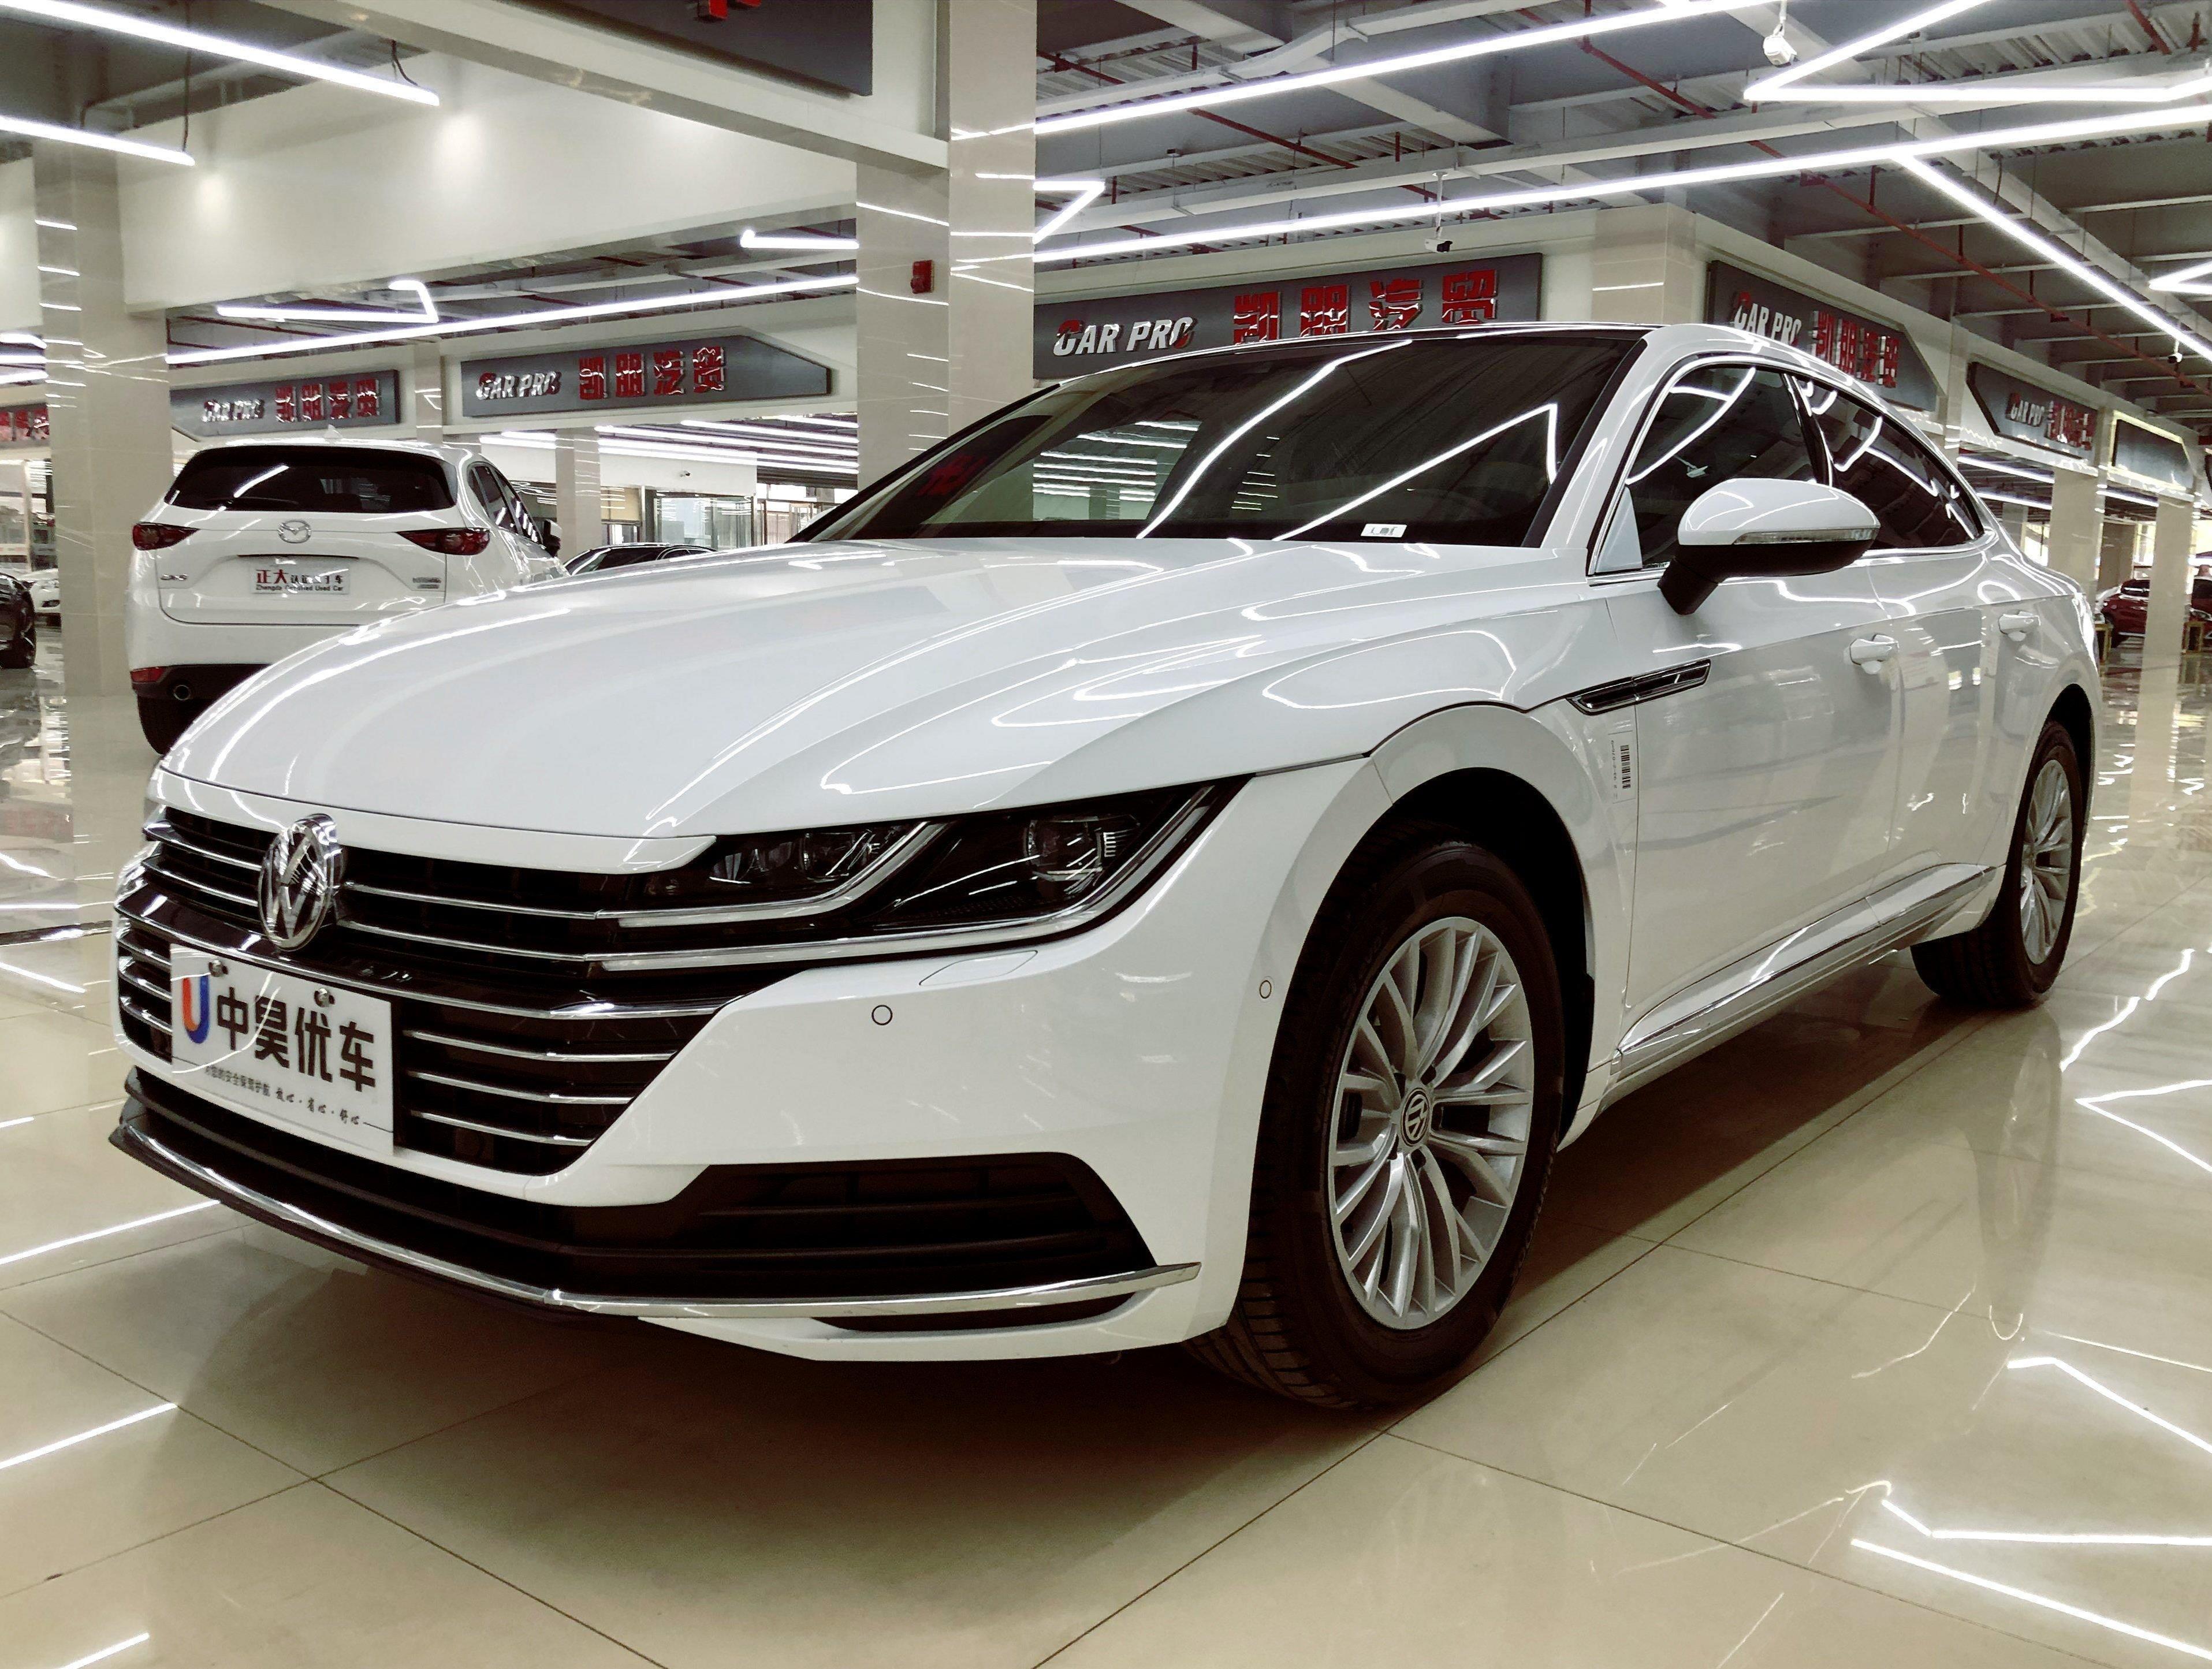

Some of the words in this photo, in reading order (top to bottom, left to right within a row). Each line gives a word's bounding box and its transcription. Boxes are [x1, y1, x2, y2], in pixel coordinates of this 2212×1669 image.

[1053, 319, 1120, 356] CAR
[1126, 317, 1194, 351] PRO
[1734, 291, 1770, 342] CAR
[1770, 312, 1802, 347] PRO
[476, 372, 515, 400] CAR
[519, 371, 562, 397] PRO
[217, 986, 375, 1092] 中昊优车
